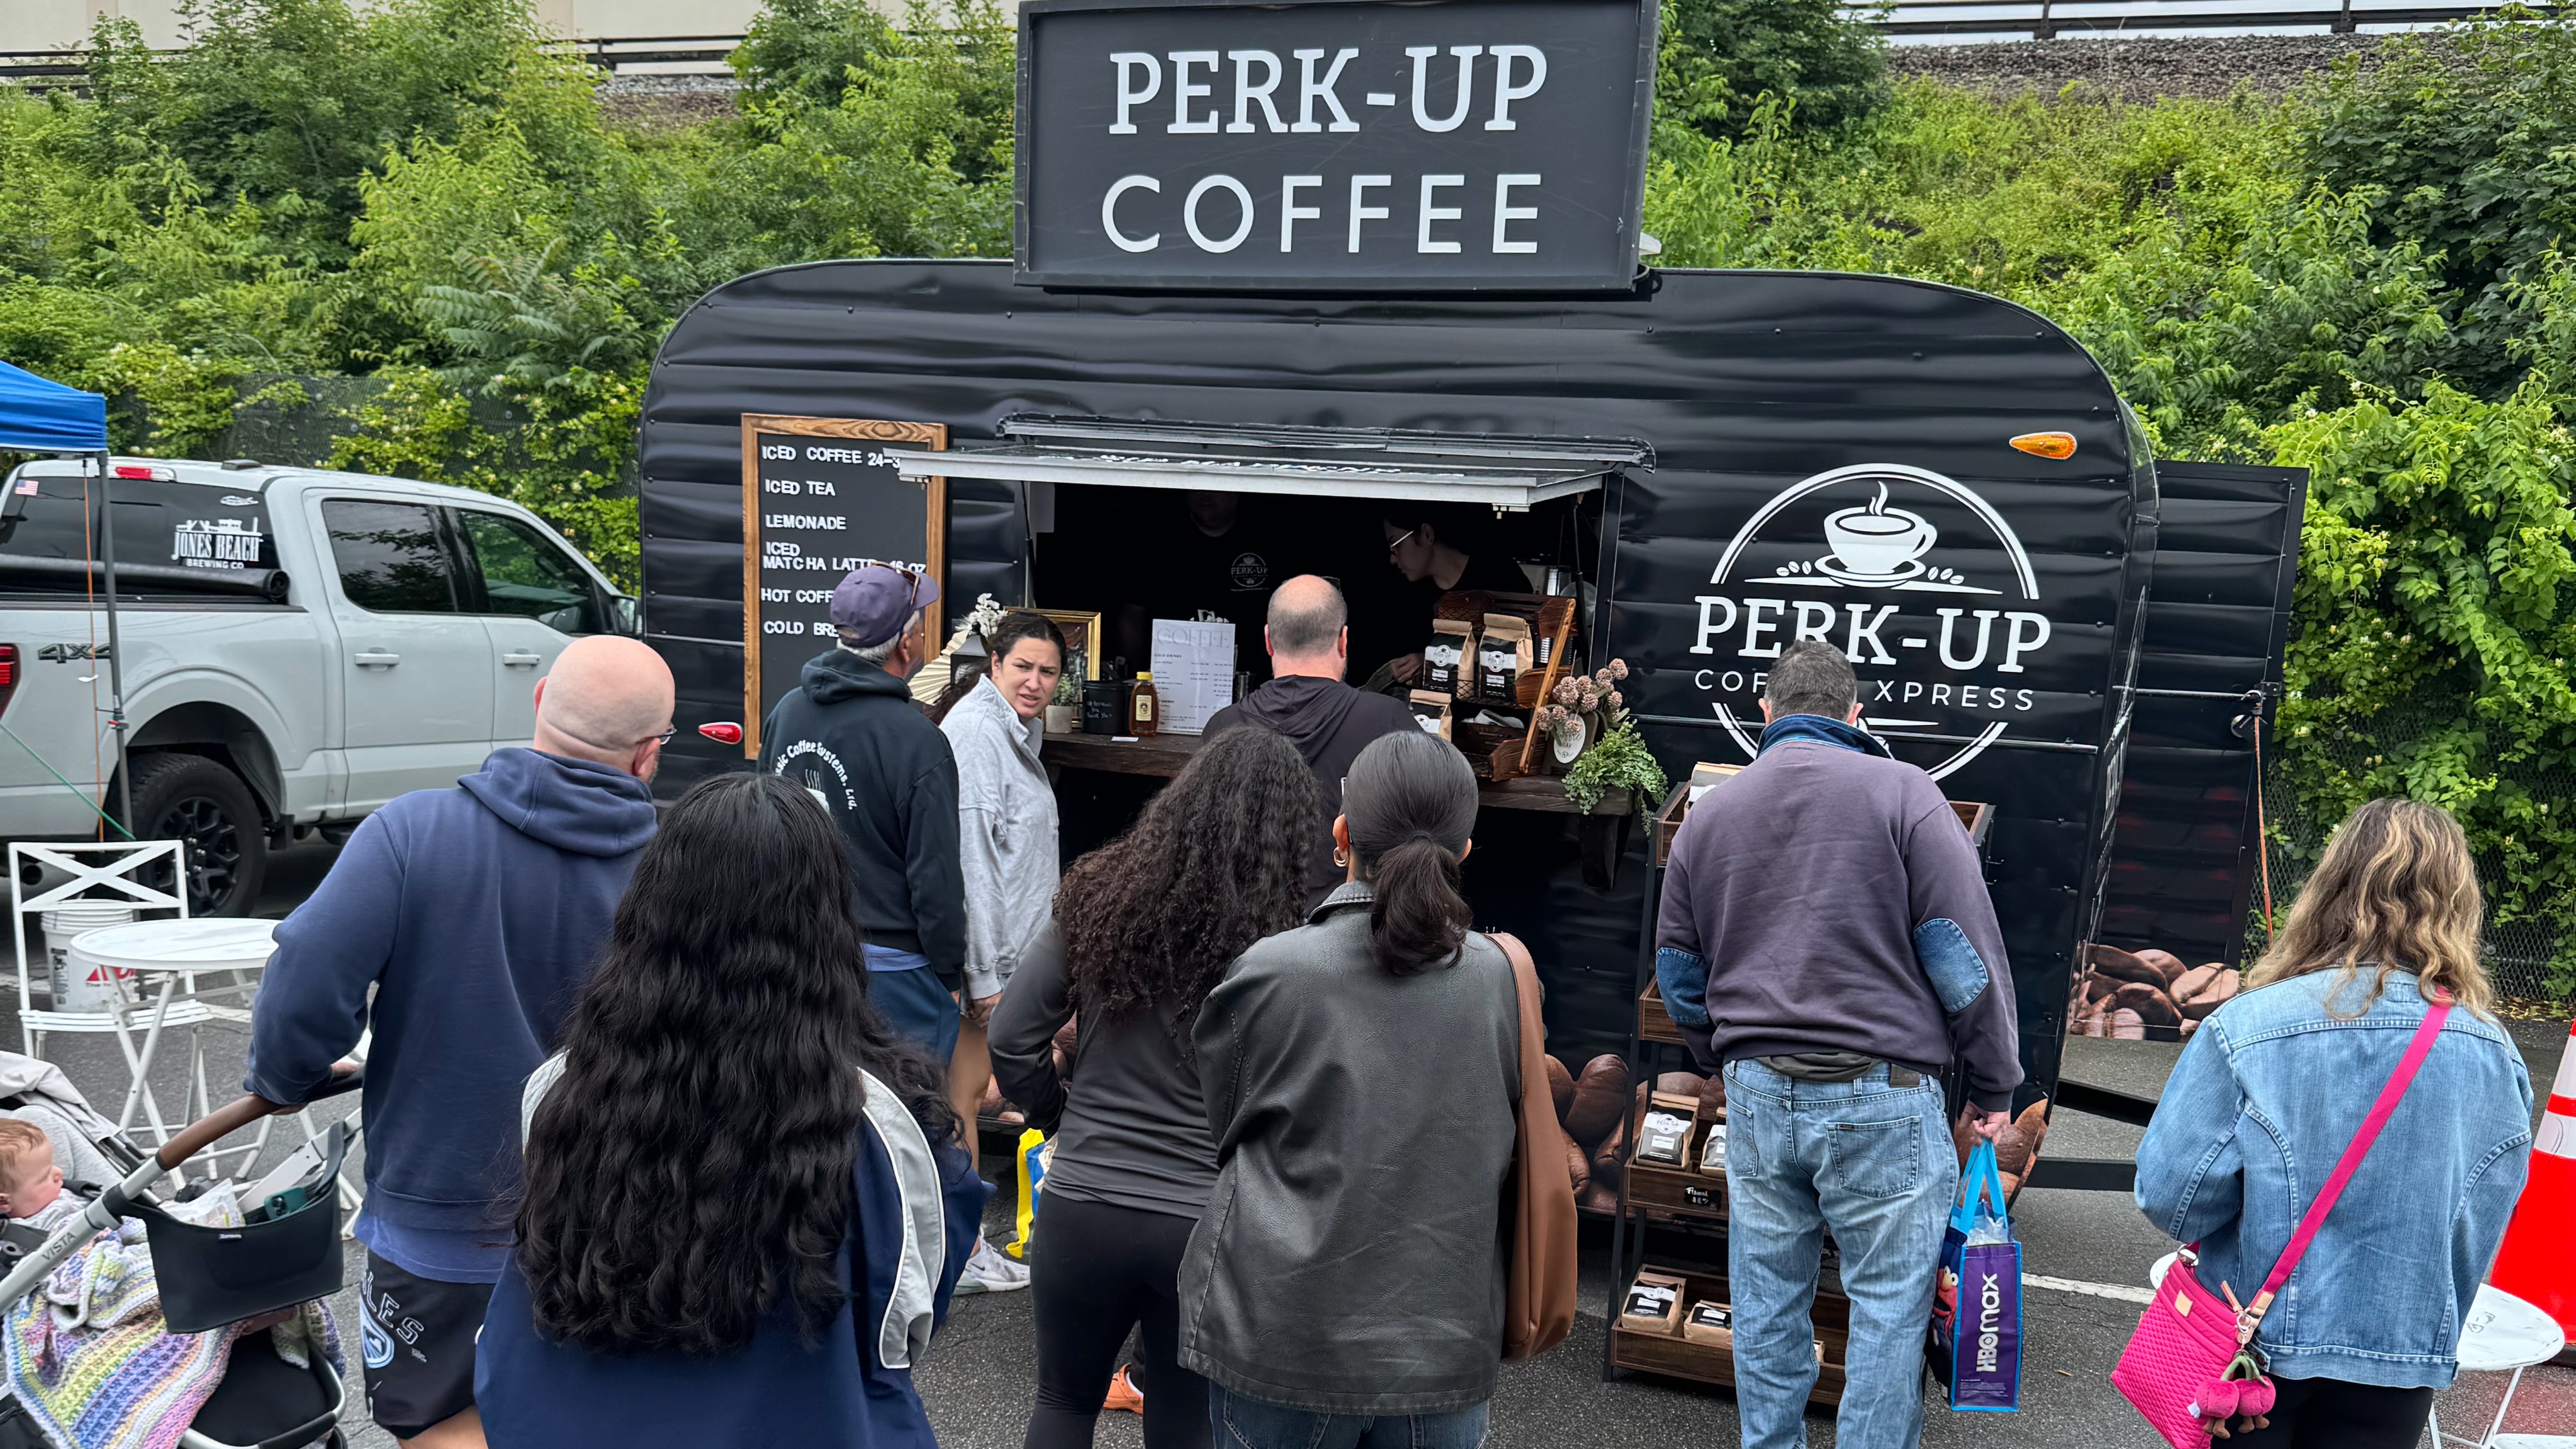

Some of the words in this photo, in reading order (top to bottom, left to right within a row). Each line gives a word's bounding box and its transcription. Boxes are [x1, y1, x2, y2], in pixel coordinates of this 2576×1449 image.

[1109, 44, 1548, 134] PERK-UP
[1102, 174, 1541, 254] COFFEE
[762, 445, 796, 460] ICED
[806, 446, 862, 464] COFFEE
[867, 452, 900, 469] 24-3
[765, 478, 800, 495] ICED
[806, 480, 836, 496] TEA
[765, 514, 847, 530] LEMONADE
[171, 531, 212, 560] JONES
[215, 535, 260, 562] BEACH
[766, 541, 800, 557] ICED
[186, 558, 229, 569] BREWING
[231, 561, 244, 569] CO
[762, 555, 827, 571] MATCHA
[761, 588, 791, 603] HOT
[796, 589, 835, 603] COFF
[763, 620, 805, 635] COLD
[813, 622, 839, 638] BRE
[1157, 627, 1231, 648] COFFEE
[1689, 595, 2051, 673] PERK-UP
[1695, 669, 1769, 693] COF
[1874, 680, 2034, 711] XPRESS
[786, 739, 816, 758] Coffee
[42, 1231, 76, 1260] VISTA
[363, 1271, 424, 1345] LES
